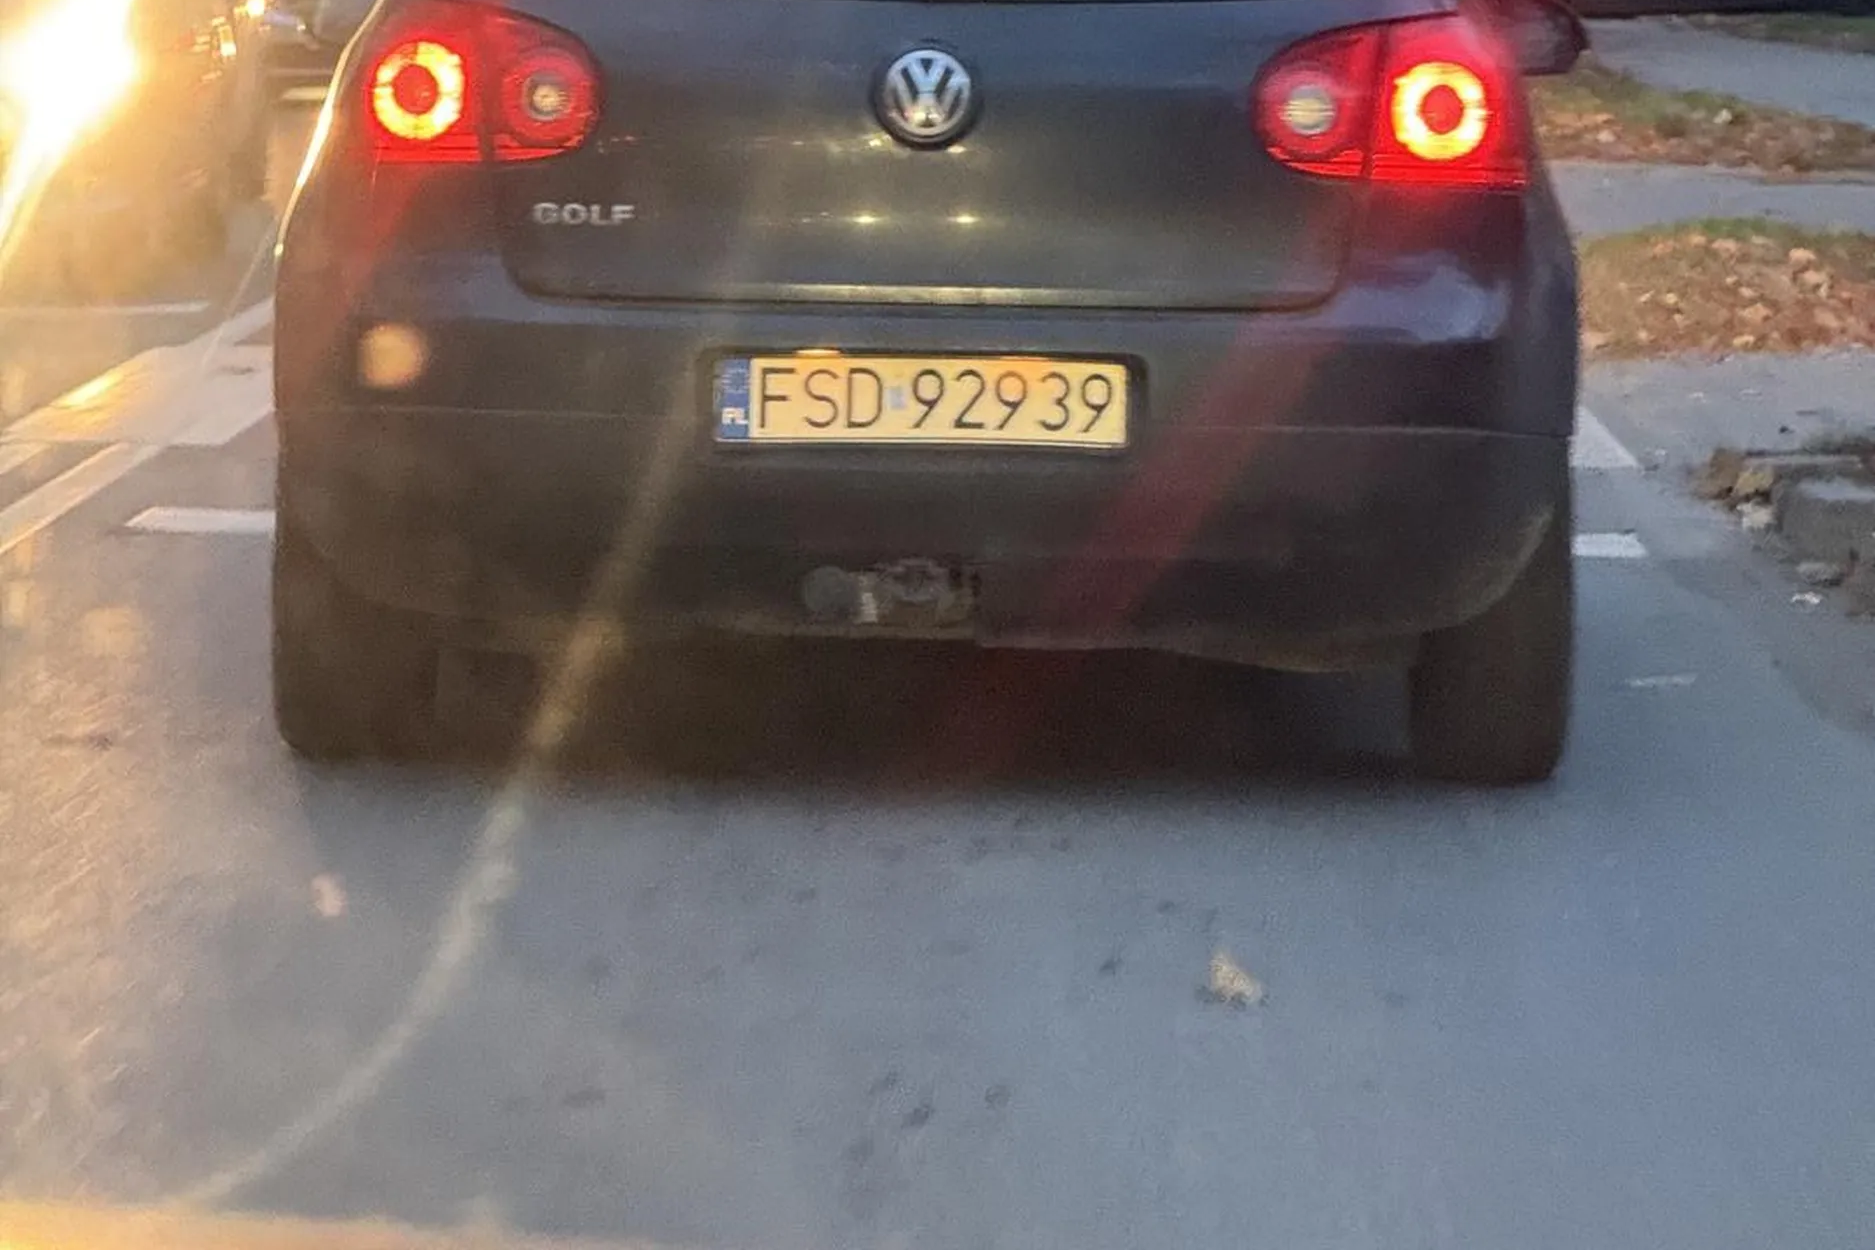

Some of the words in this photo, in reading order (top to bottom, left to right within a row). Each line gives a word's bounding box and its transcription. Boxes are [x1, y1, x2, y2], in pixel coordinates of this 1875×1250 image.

[887, 50, 971, 136] VW
[532, 202, 635, 225] GOLF
[758, 367, 883, 429] FSD
[911, 368, 1113, 433] 92939
